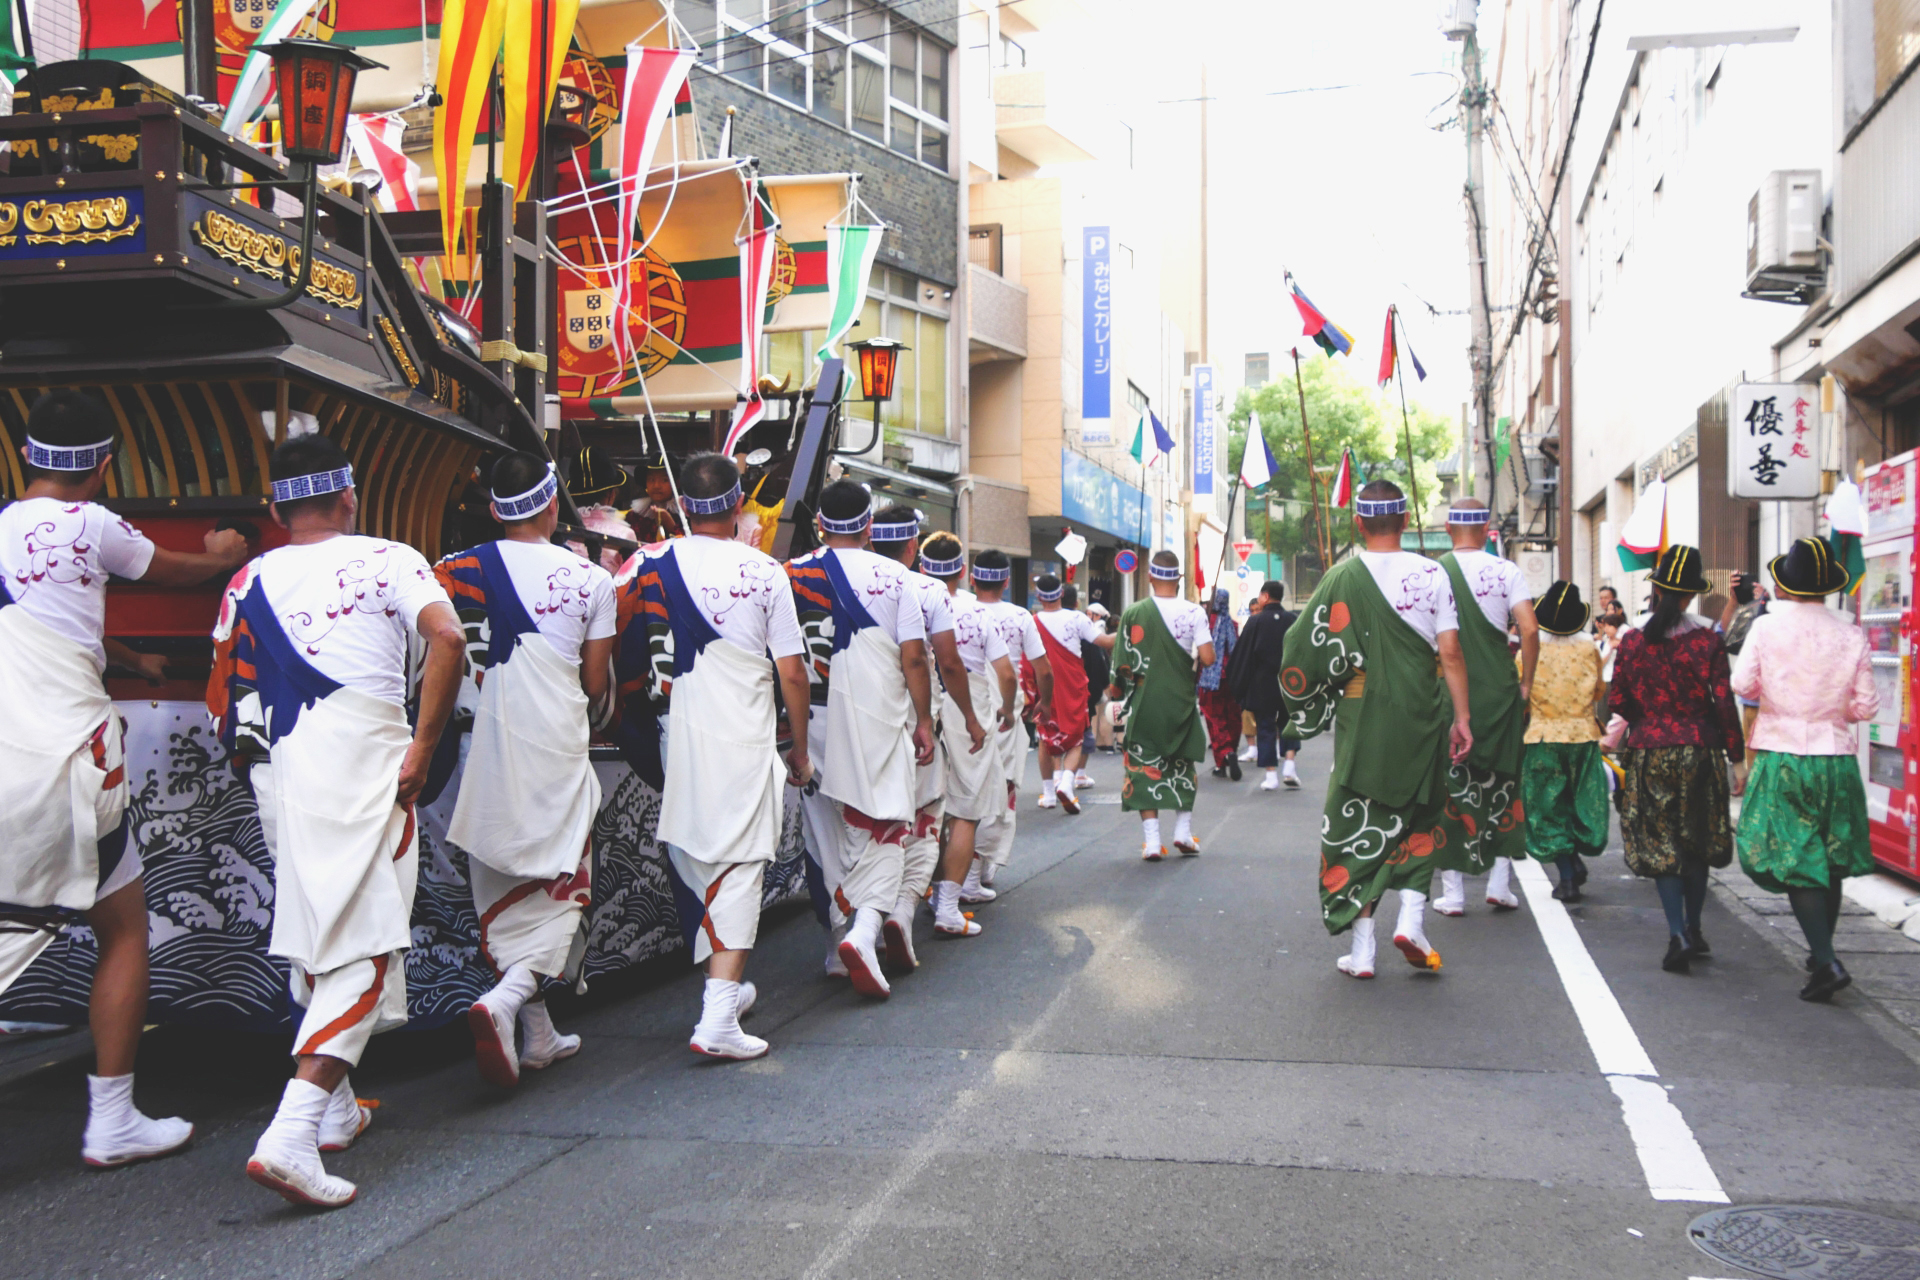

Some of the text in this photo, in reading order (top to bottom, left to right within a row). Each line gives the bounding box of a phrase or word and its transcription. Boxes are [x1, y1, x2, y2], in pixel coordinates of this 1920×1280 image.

[1090, 236, 1106, 255] P
[1094, 261, 1110, 374] みなとガレージ
[1789, 396, 1810, 459] 食事処
